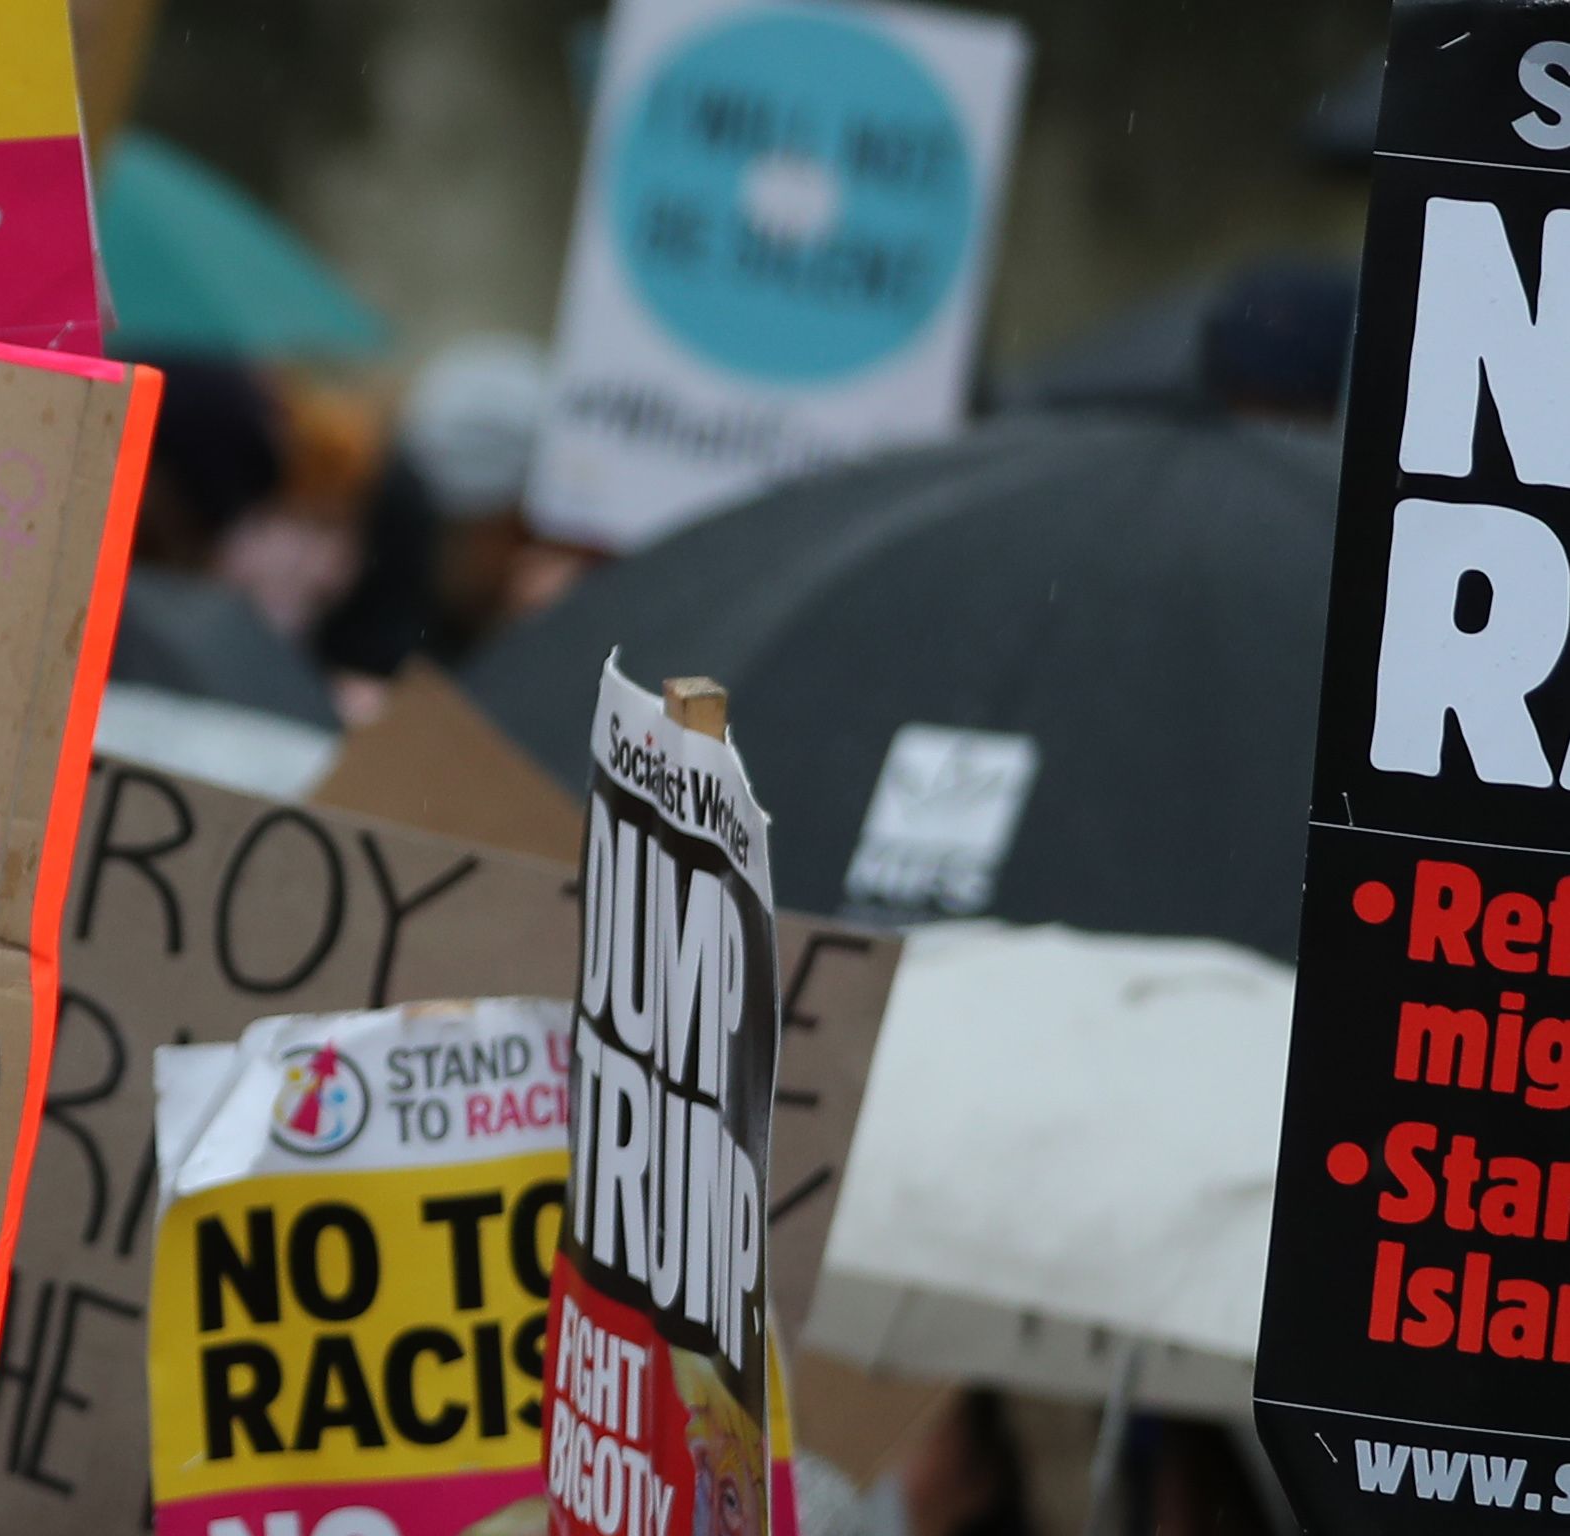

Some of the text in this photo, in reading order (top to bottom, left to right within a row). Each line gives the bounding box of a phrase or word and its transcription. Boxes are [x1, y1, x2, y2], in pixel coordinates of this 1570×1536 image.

[1370, 497, 1570, 790] R
[75, 755, 479, 1008] ROY
[579, 790, 745, 1114] DUMP
[387, 1033, 532, 1094] STAND
[387, 1097, 451, 1145] TO
[196, 1178, 567, 1334] NO TO
[573, 1014, 759, 1372] TRUMP
